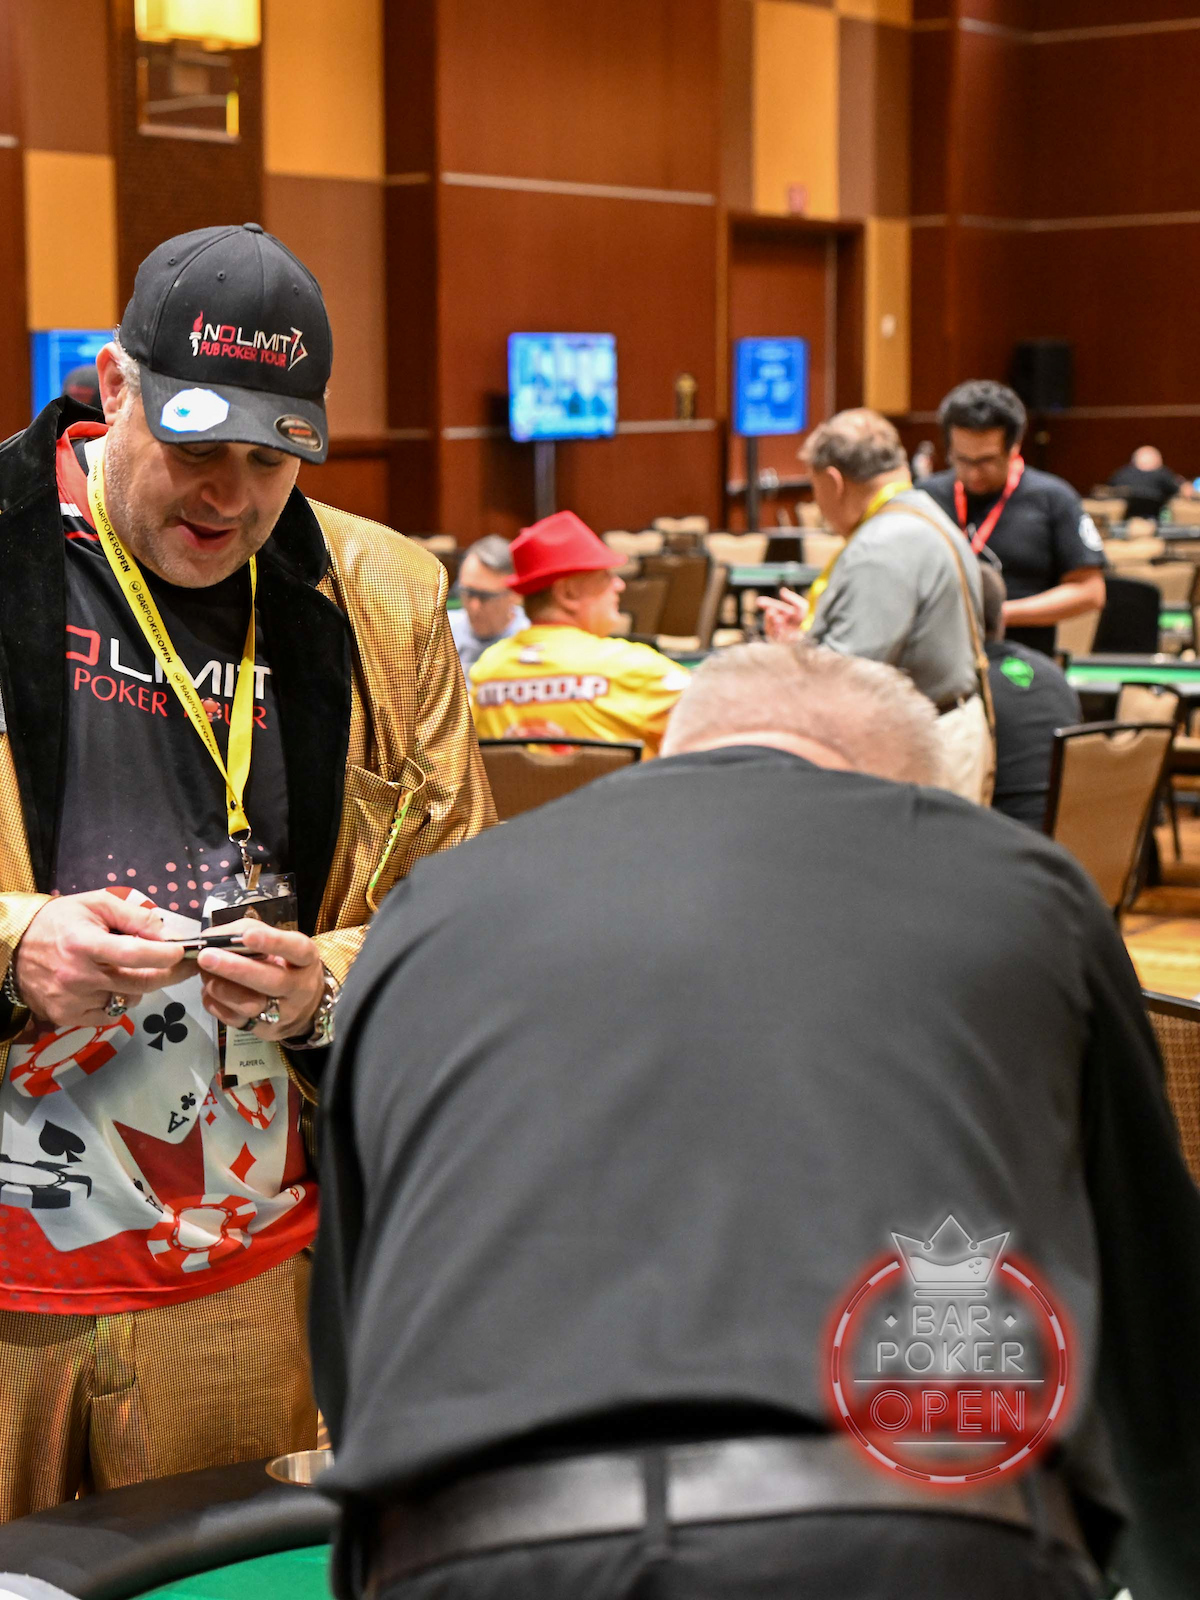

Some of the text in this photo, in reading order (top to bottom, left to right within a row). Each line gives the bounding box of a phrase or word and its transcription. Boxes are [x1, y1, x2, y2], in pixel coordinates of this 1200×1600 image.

[200, 341, 287, 368] PUB POKER TOUR
[203, 323, 292, 353] NO LIMIT
[95, 501, 131, 573] BARPOKEROPEN
[135, 593, 174, 664] BARPOKEROPEN
[74, 667, 169, 717] POKER
[109, 637, 273, 700] LIMIT
[179, 684, 217, 756] BARPOKEROPEN
[202, 1087, 218, 1106] A
[167, 1111, 189, 1134] A
